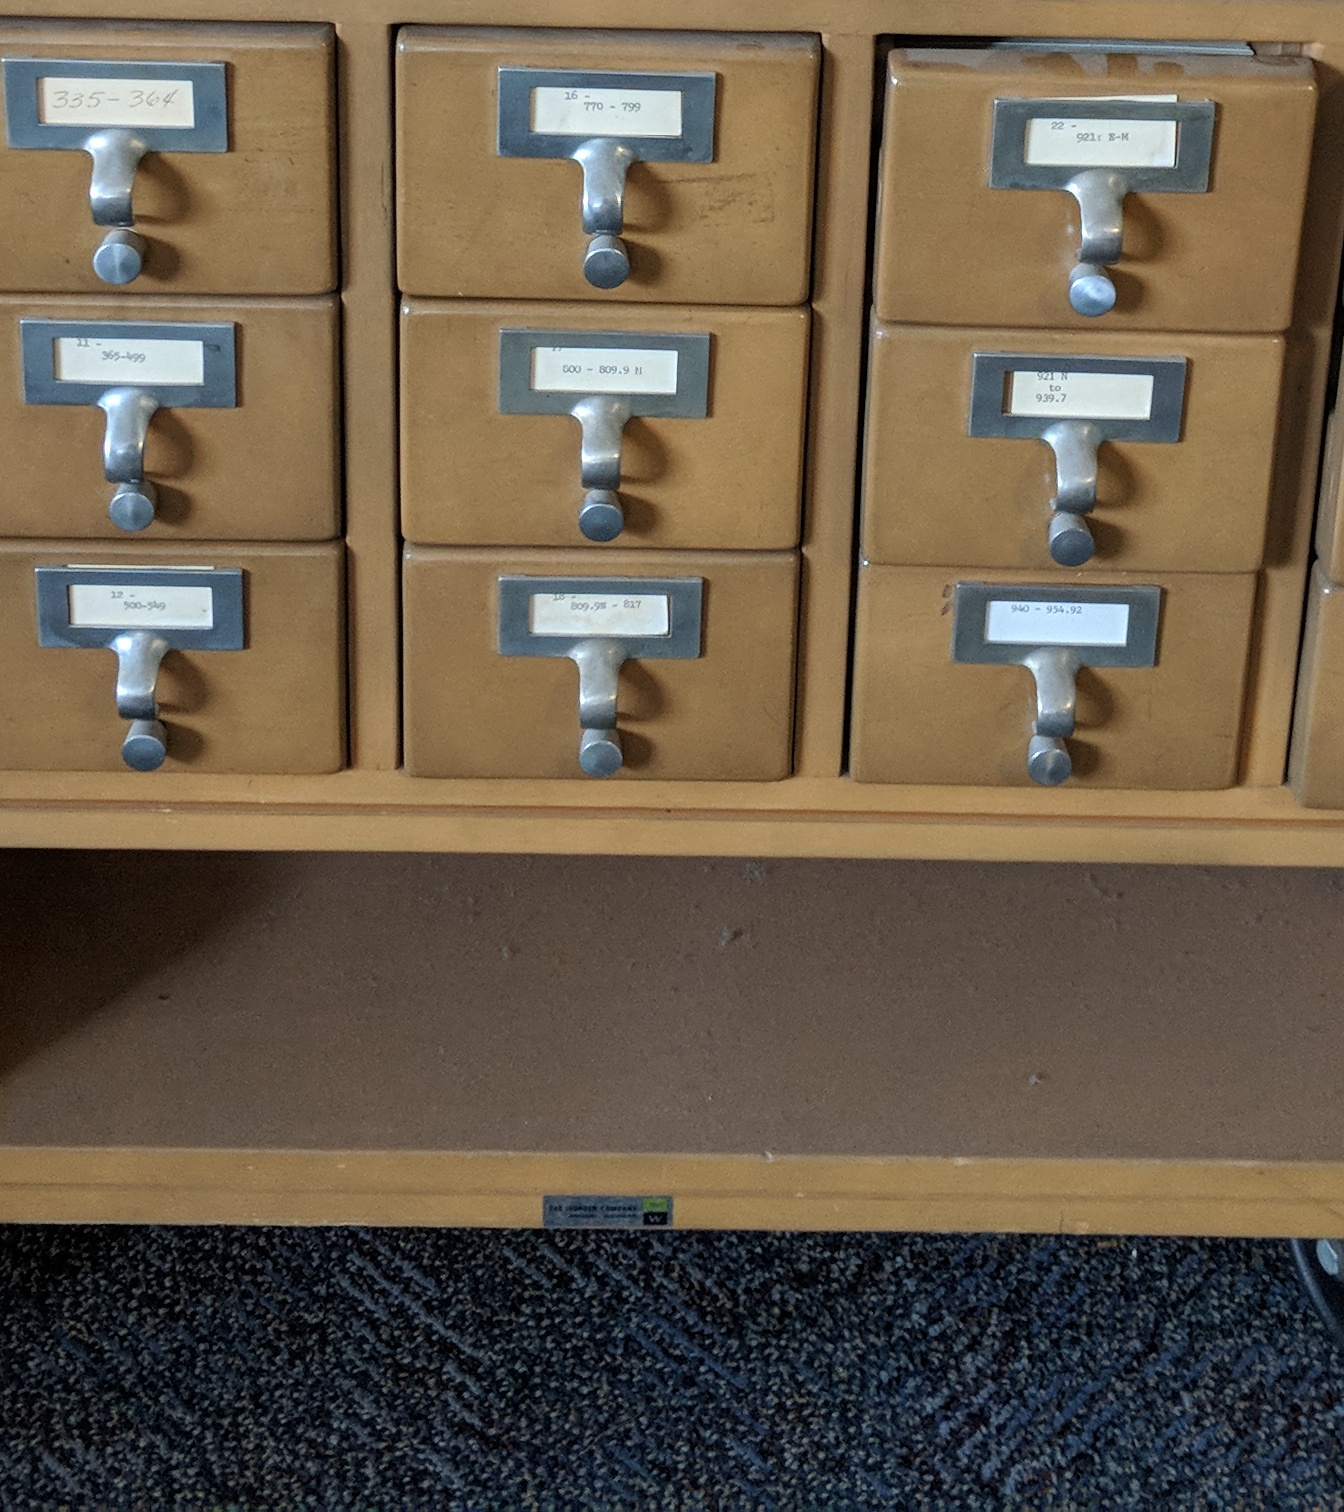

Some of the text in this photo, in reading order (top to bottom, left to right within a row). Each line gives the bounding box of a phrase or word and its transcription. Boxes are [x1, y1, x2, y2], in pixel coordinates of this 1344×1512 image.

[129, 88, 180, 108] 364
[565, 91, 578, 101] 16
[584, 102, 603, 111] 770
[622, 102, 641, 112] 799
[1051, 121, 1064, 130] 22
[102, 351, 146, 363] 365-499
[563, 365, 581, 373] 800
[599, 365, 629, 375] 809.9
[1037, 372, 1068, 381] 921 N
[1049, 384, 1061, 392] to
[1036, 394, 1067, 403] 939.7
[124, 601, 166, 610] 500-549
[623, 601, 641, 609] 817
[1011, 605, 1029, 613] 940
[1046, 606, 1082, 614] 954.92
